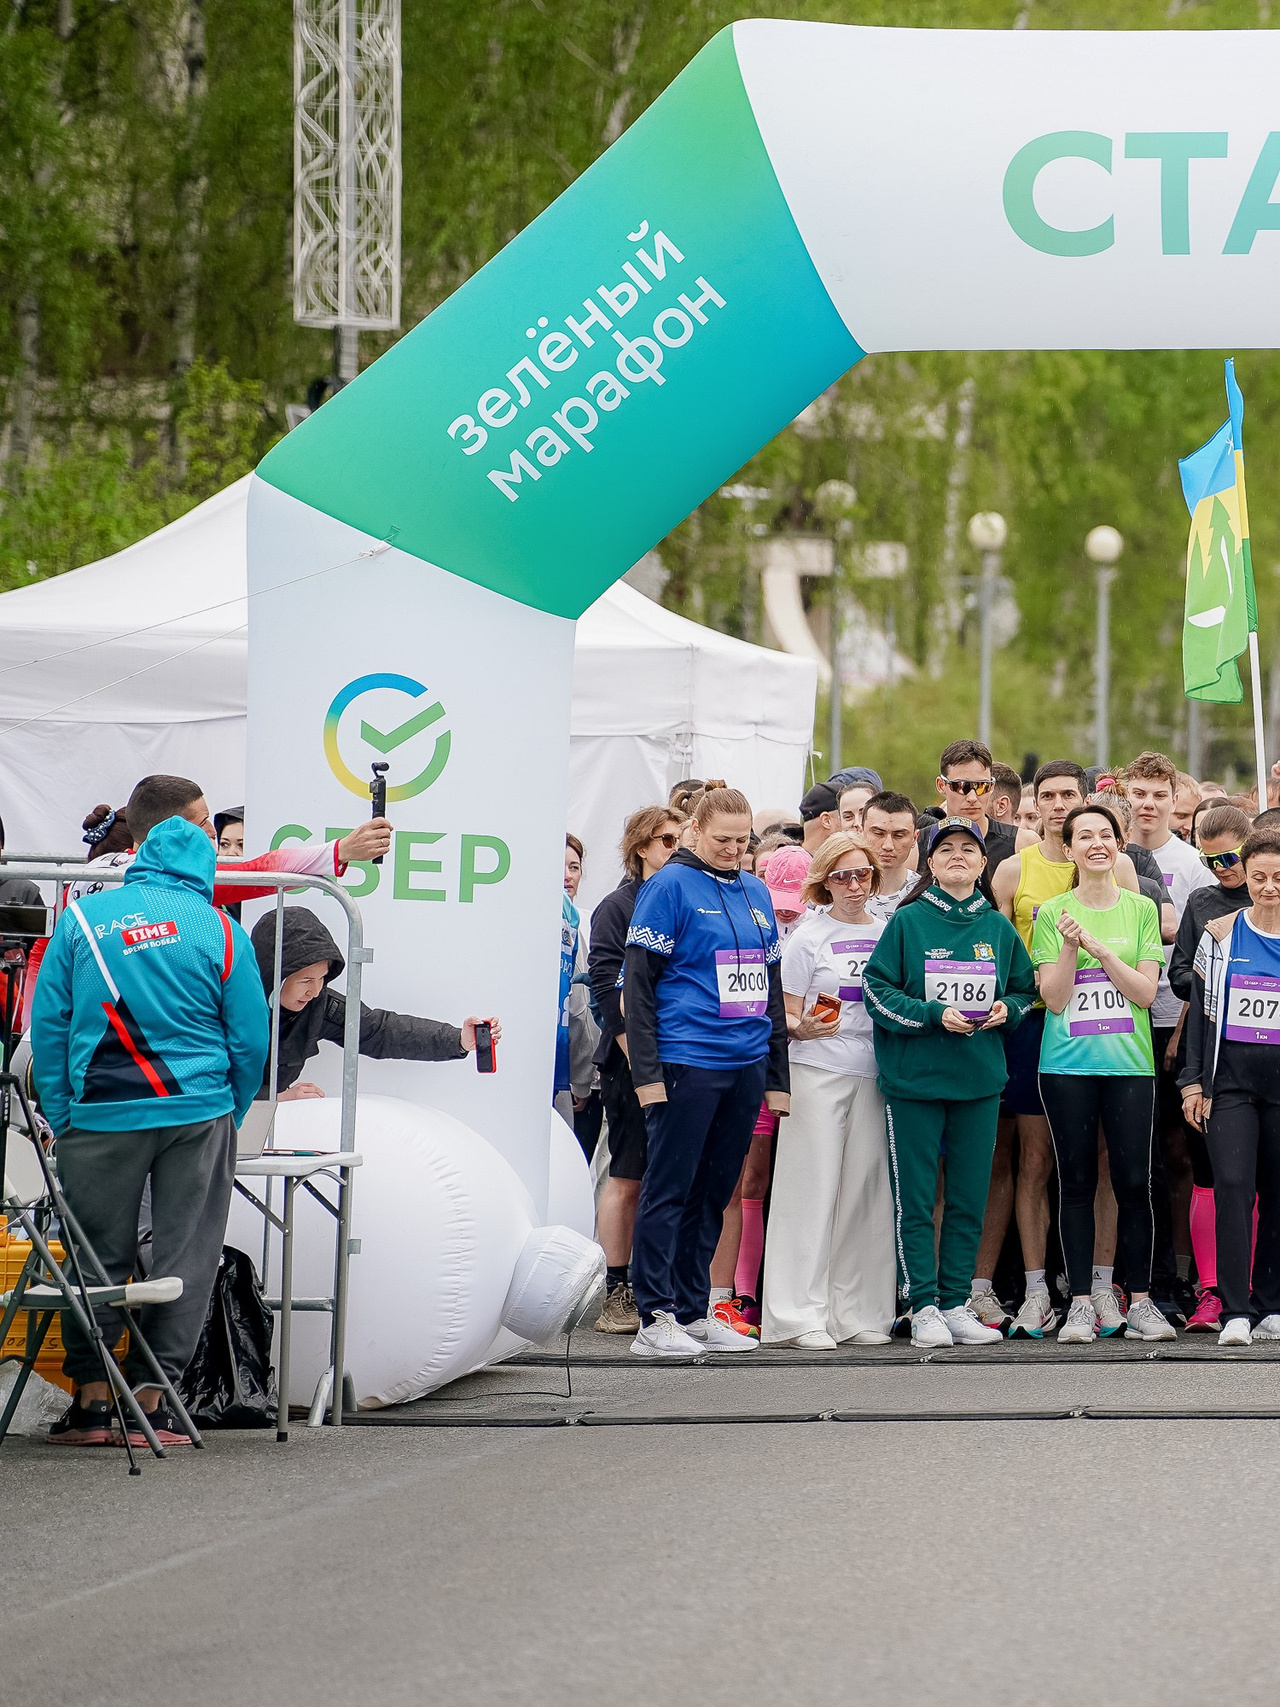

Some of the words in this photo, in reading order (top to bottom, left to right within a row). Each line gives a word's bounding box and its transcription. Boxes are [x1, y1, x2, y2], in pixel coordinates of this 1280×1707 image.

[446, 219, 685, 456] зелёный
[486, 275, 727, 503] марафон
[94, 912, 149, 939] RACE
[128, 924, 170, 942] TIME
[122, 942, 149, 956] ВРЕМЯ
[727, 972, 763, 992] 2000
[936, 982, 987, 1001] 2186
[1077, 989, 1125, 1011] 2100
